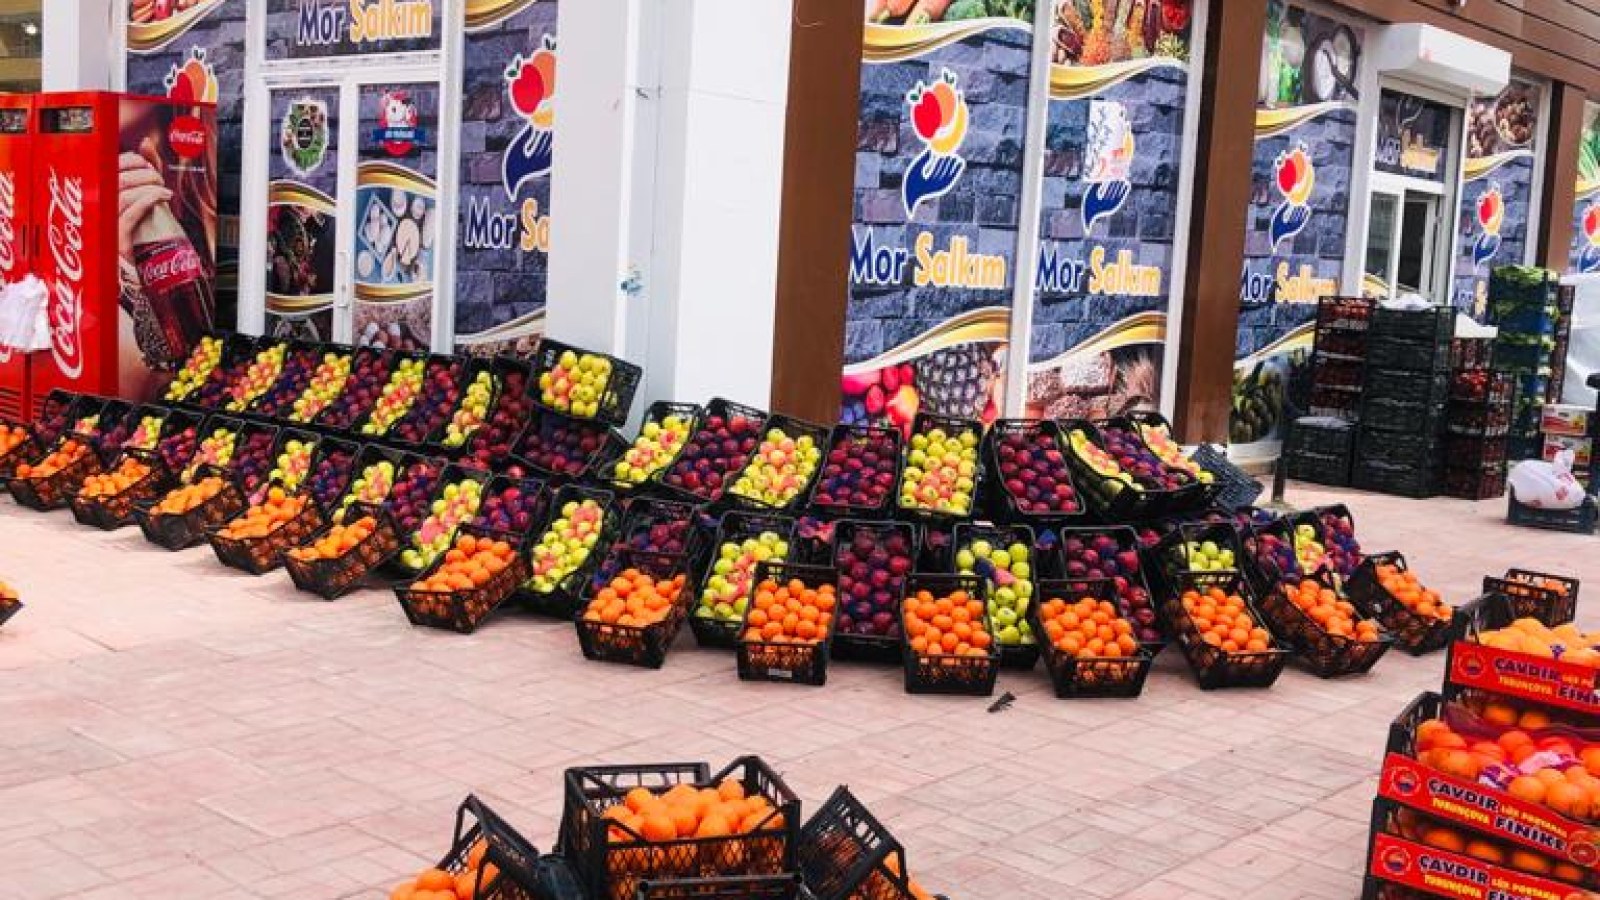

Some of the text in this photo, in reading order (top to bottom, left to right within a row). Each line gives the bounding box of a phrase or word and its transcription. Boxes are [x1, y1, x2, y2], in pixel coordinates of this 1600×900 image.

[297, 0, 432, 46] Mor Salkım
[465, 195, 517, 249] Mor
[49, 164, 83, 379] Coca-Cola
[850, 223, 1005, 289] Mor Salkım
[1034, 240, 1085, 293] Mor
